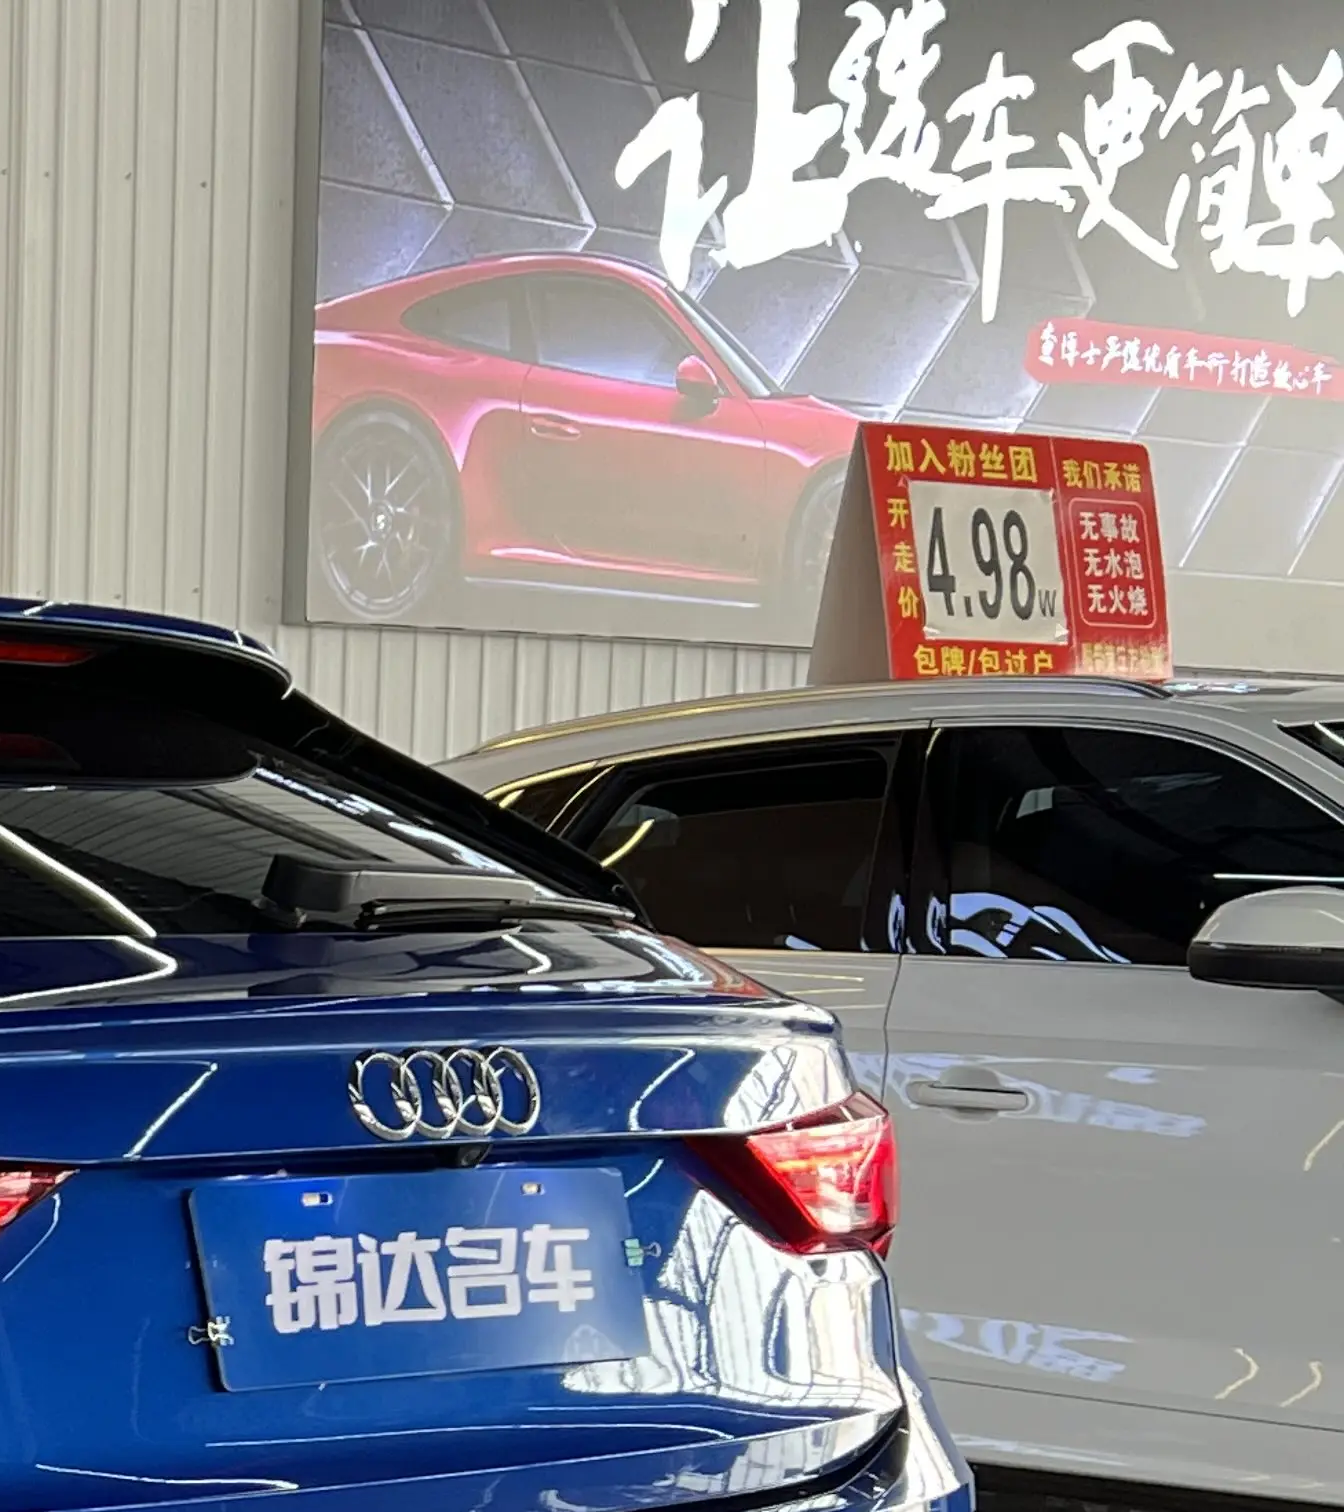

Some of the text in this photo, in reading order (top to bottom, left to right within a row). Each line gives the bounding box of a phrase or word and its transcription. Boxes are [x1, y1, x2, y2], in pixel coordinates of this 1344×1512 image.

[883, 434, 1038, 483] 加入粉丝团
[1062, 459, 1142, 493] 我们承诺
[1079, 511, 1141, 543] 无事故
[887, 498, 920, 619] 开走价
[1083, 548, 1145, 580] 无水泡
[1087, 584, 1149, 616] 无火烧
[913, 644, 1054, 677] 包牌/包过户
[263, 1224, 594, 1334] 锦达名车
